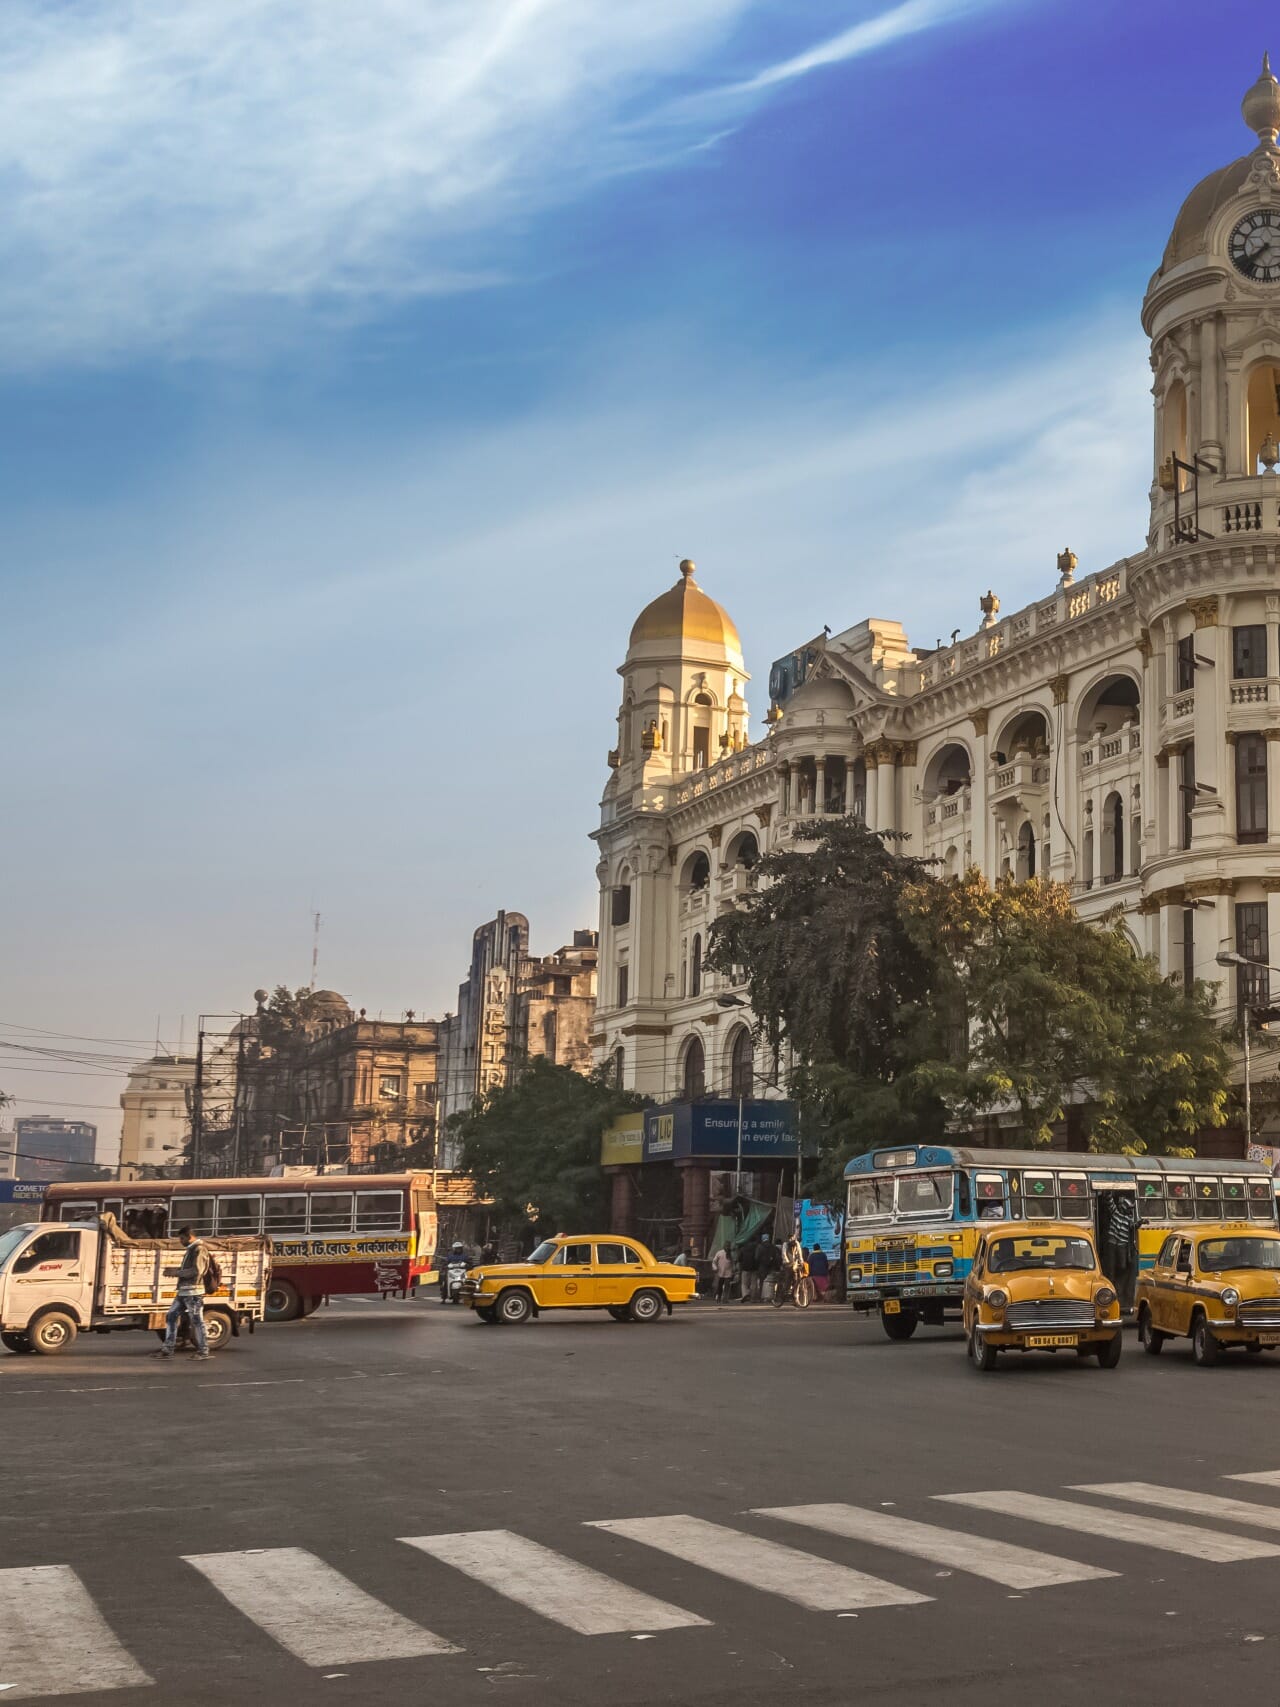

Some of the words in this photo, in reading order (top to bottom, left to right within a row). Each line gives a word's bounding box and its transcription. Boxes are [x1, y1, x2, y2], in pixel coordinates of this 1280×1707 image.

[482, 980, 506, 1091] METR
[660, 1118, 671, 1140] LIC
[753, 1134, 779, 1144] every
[782, 1133, 797, 1142] fac
